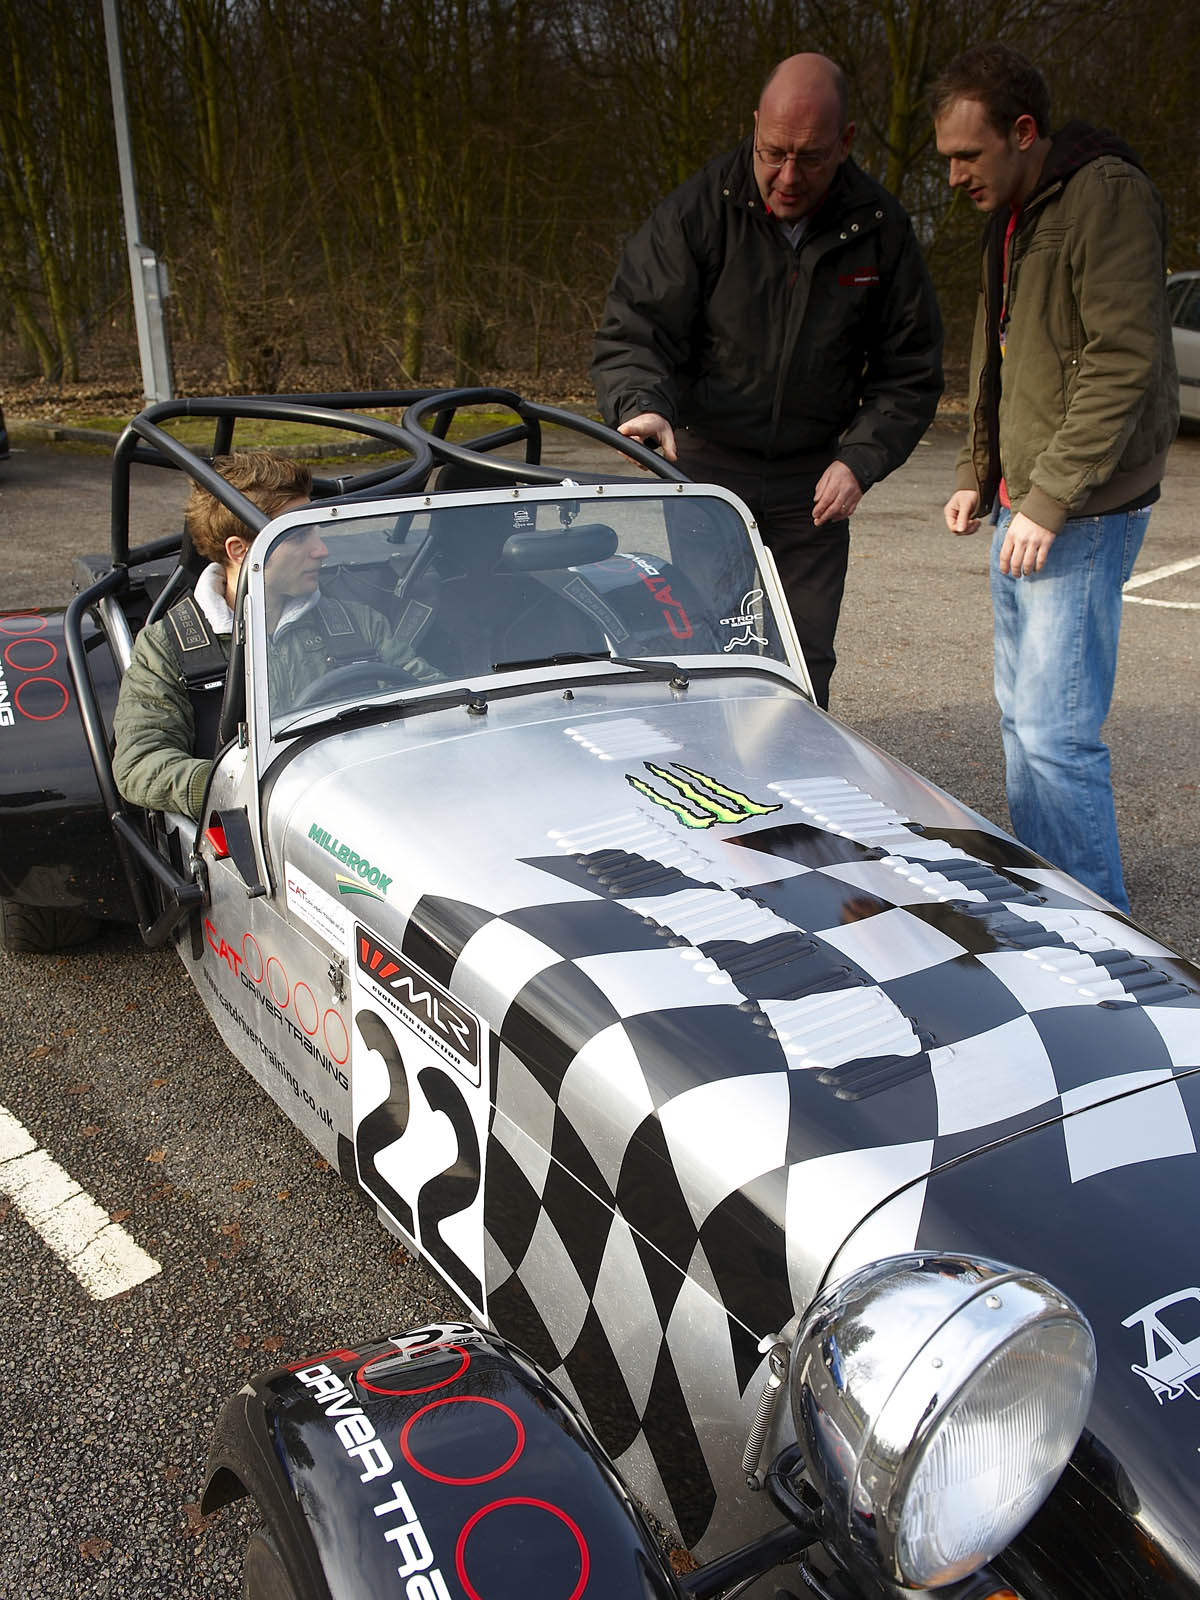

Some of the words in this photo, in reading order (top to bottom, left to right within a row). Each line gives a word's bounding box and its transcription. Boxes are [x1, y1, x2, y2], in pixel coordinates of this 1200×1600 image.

[637, 572, 693, 639] CAT
[288, 879, 307, 900] CAT
[308, 822, 393, 895] MILLBROOK
[205, 917, 243, 977] CAT
[240, 971, 285, 1025] DRIVER
[284, 1019, 349, 1092] TRAINING
[371, 984, 416, 1026] evolution
[416, 1023, 427, 1036] in
[428, 1034, 462, 1066] action
[389, 976, 471, 1052] MLR
[202, 966, 335, 1132] www.catdrivertraining.co.uk
[355, 1008, 485, 1316] 22
[294, 1363, 395, 1484] DRIVER
